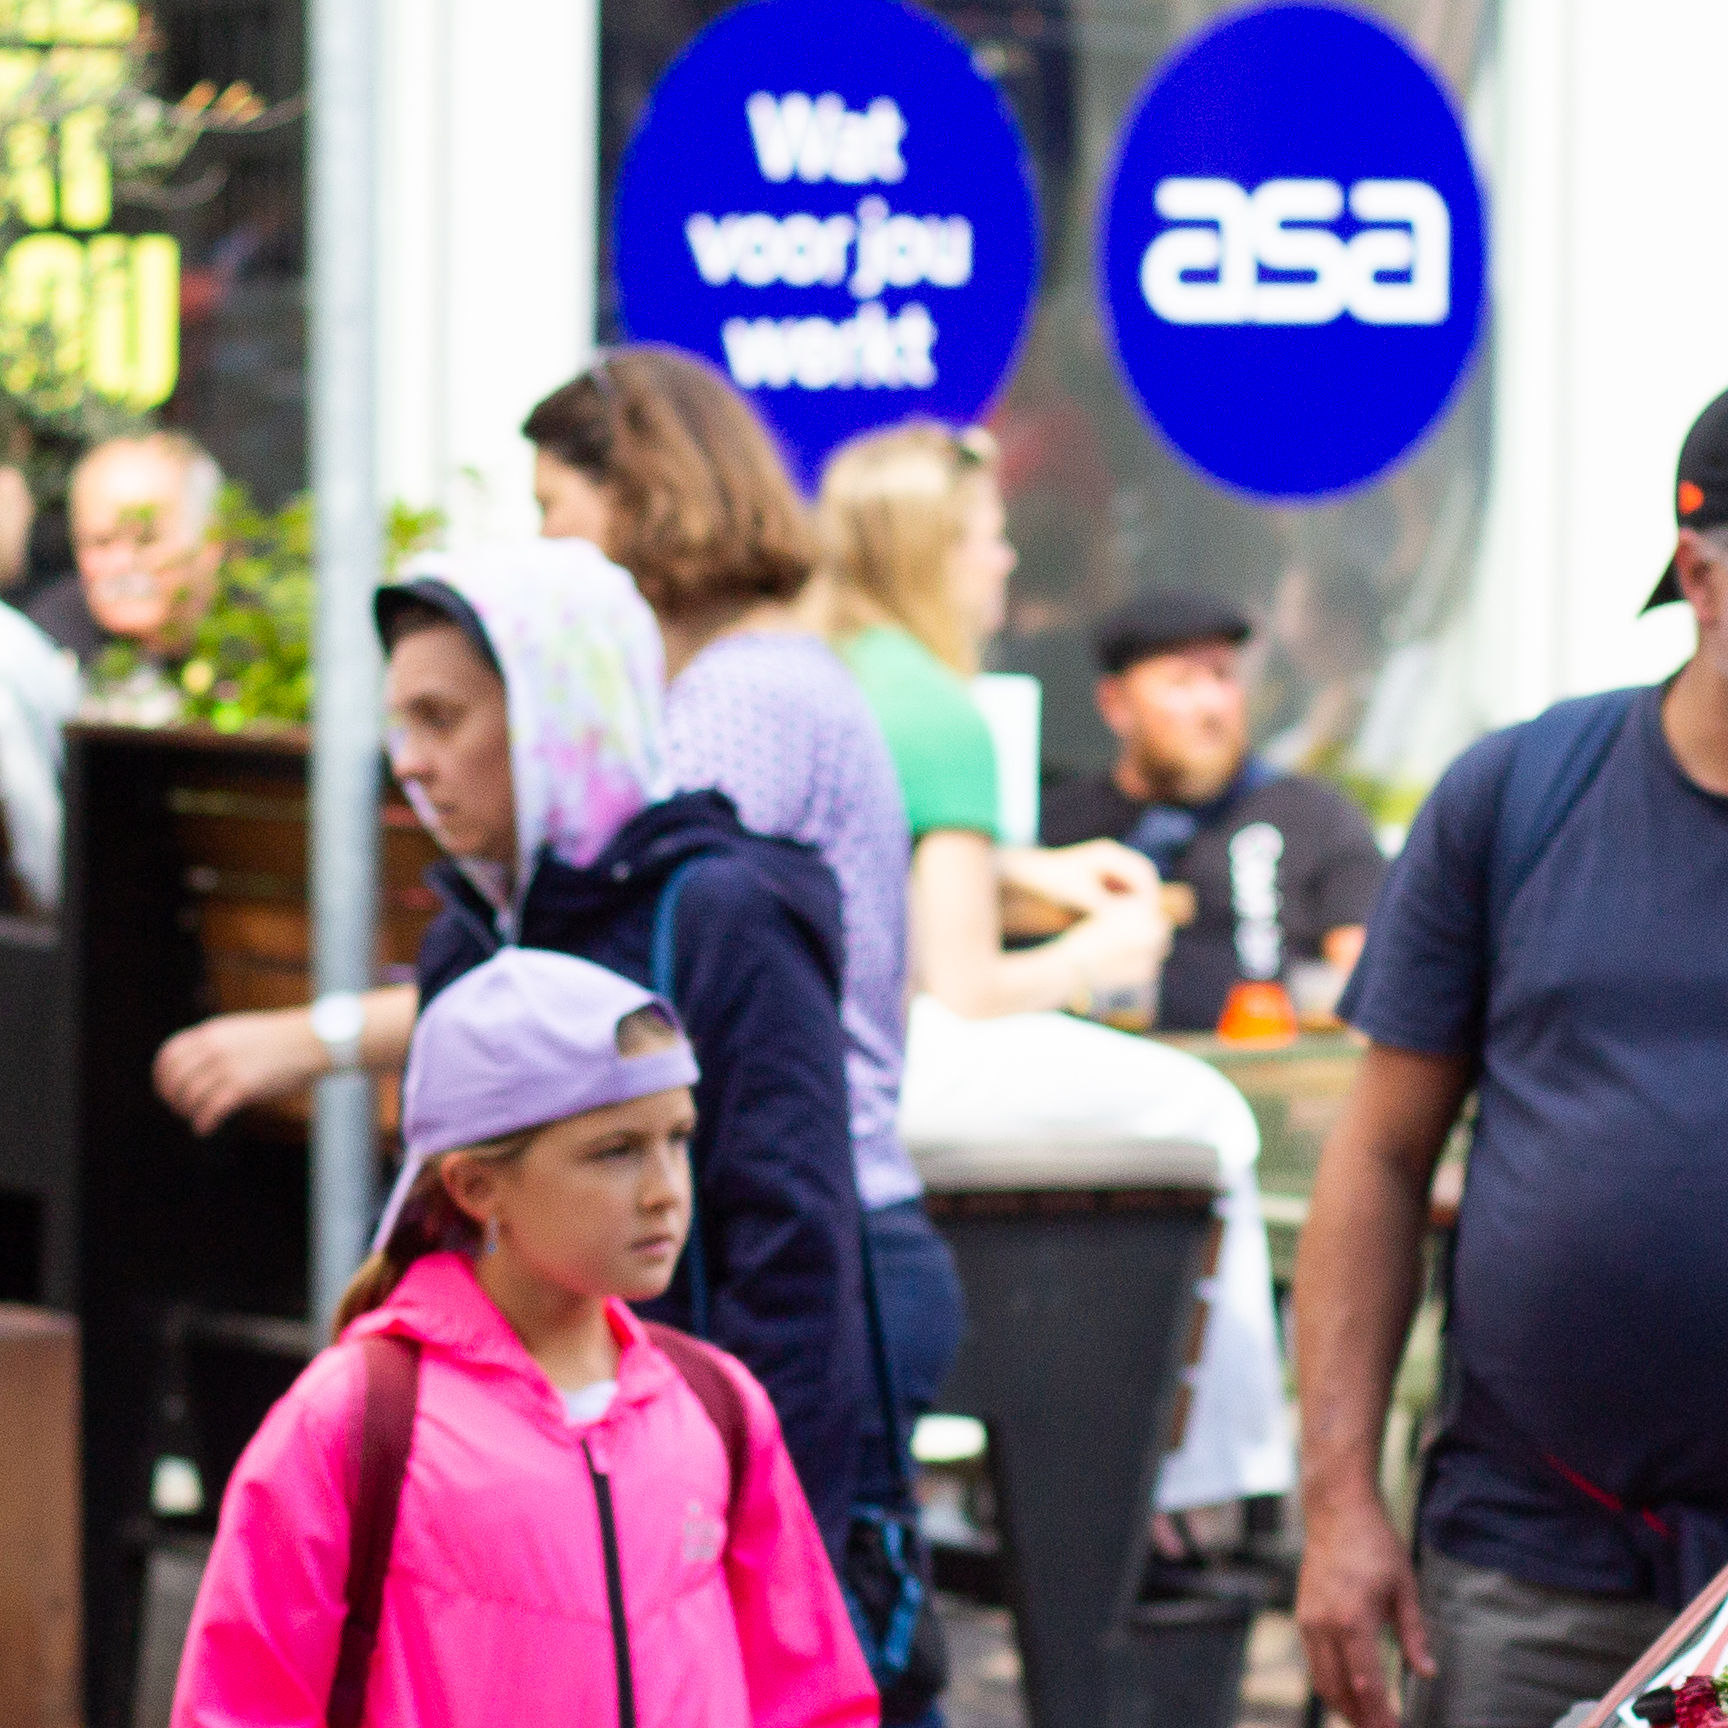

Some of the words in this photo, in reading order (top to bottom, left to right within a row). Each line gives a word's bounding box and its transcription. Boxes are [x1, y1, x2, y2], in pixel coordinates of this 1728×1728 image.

[746, 90, 908, 185] Wat
[685, 211, 853, 288] voor
[848, 194, 974, 299] jou
[1141, 178, 1450, 325] asa
[720, 303, 938, 390] werkt
